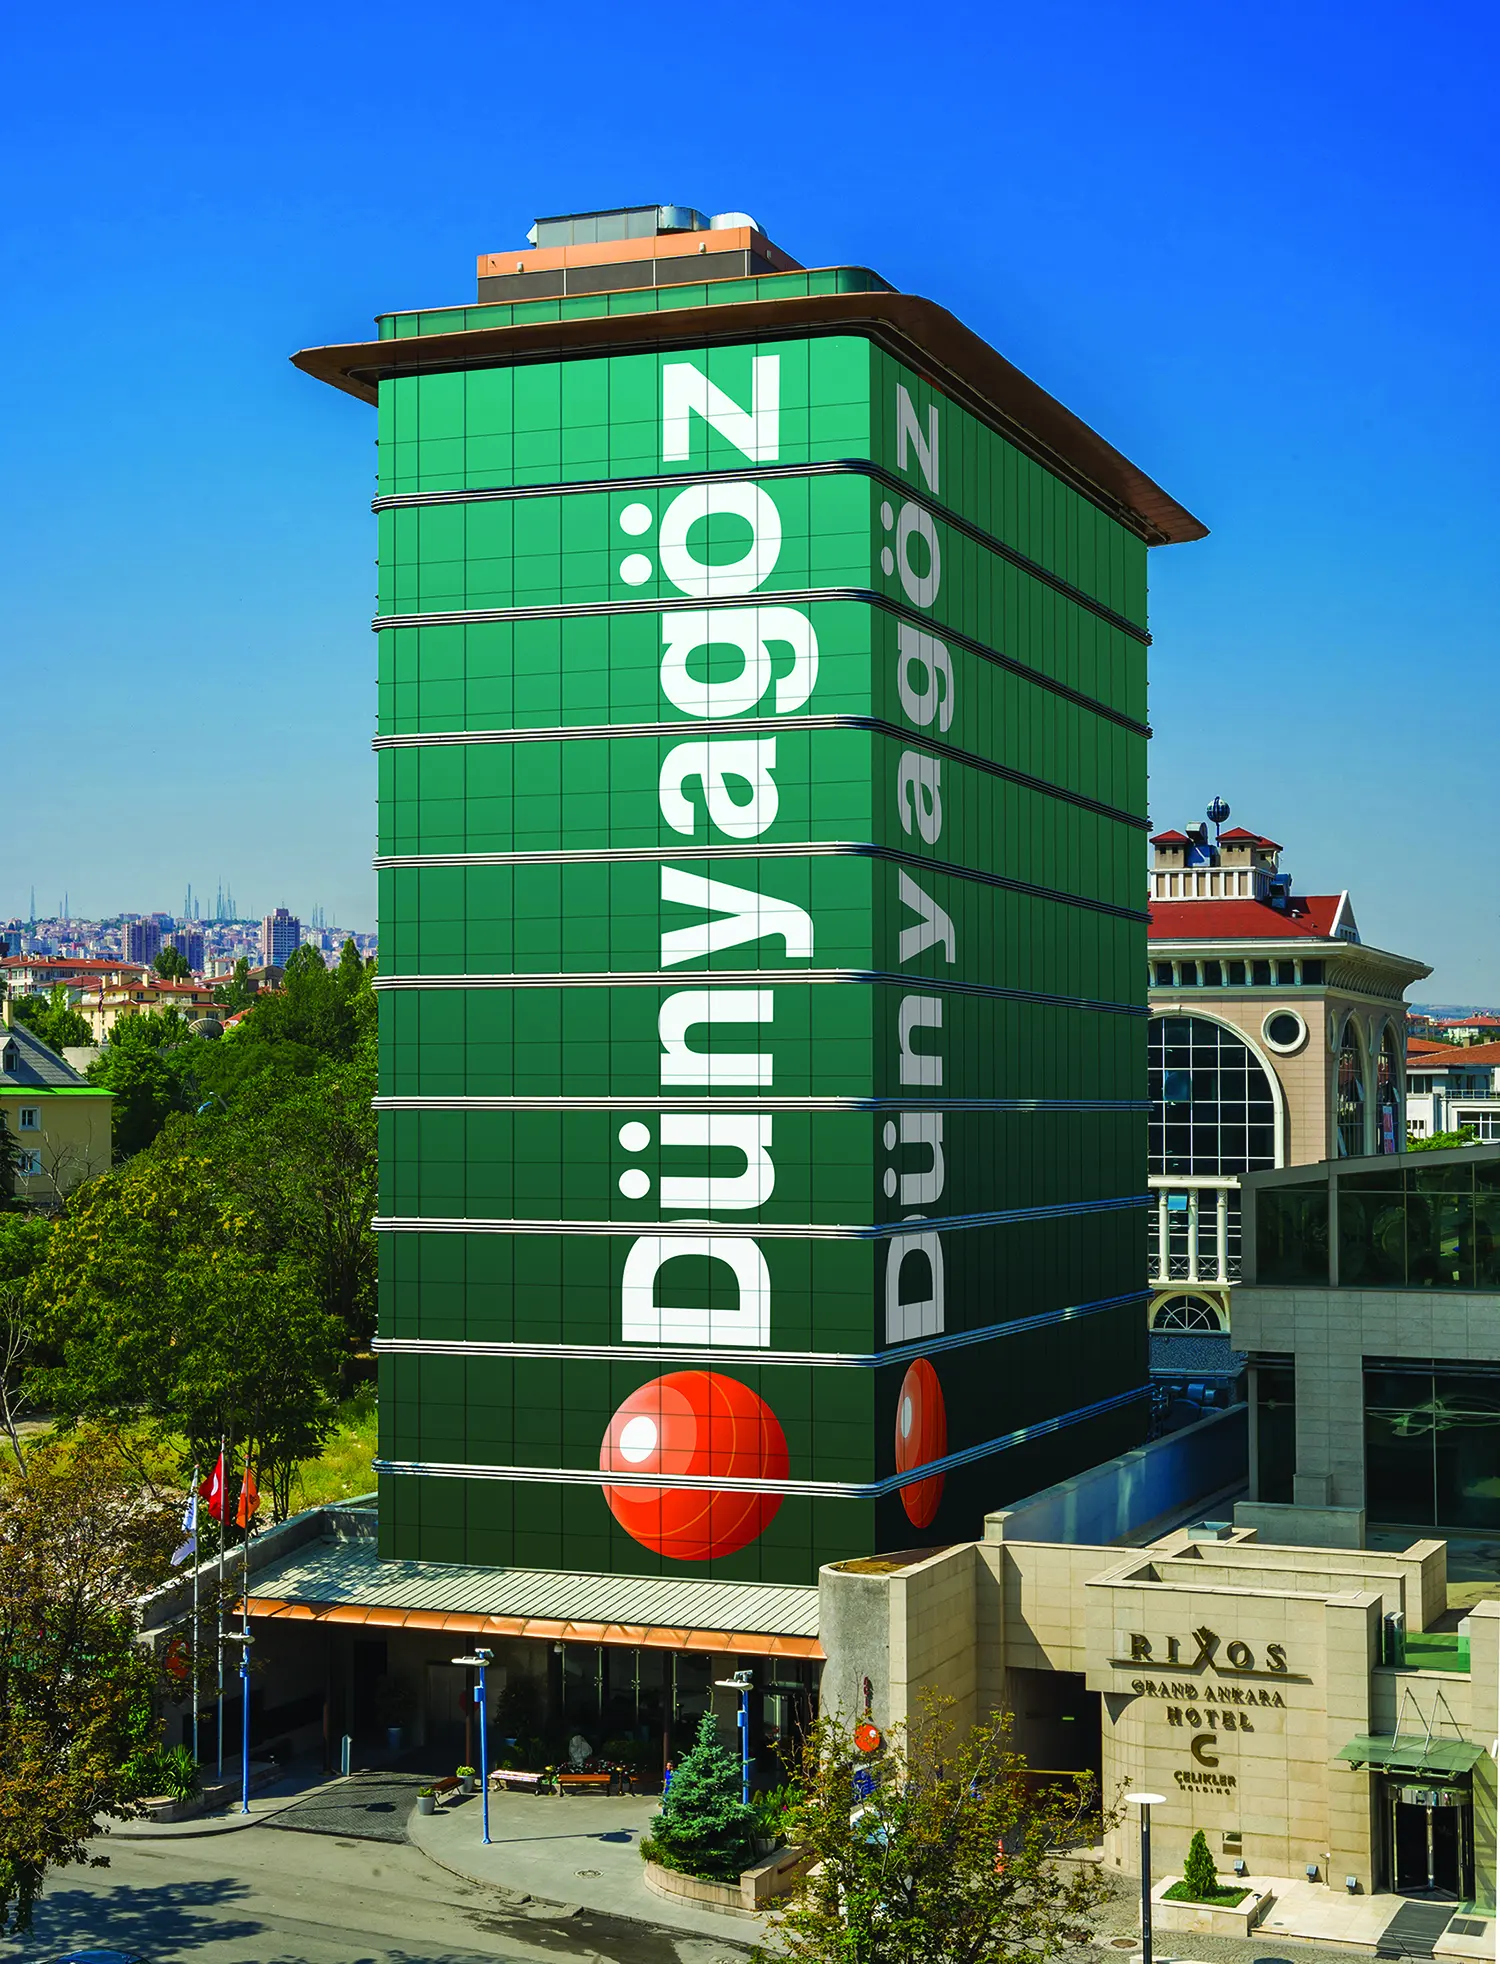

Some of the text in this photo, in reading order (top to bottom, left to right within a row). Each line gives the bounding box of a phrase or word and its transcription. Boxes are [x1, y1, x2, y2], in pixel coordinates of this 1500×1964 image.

[619, 354, 818, 1347] Dünyagöz
[880, 383, 955, 1344] Dünyagöz
[1129, 1625, 1288, 1673] RIXOS
[1131, 1679, 1287, 1708] GRAND ANKARA
[1166, 1706, 1254, 1732] HOTEL
